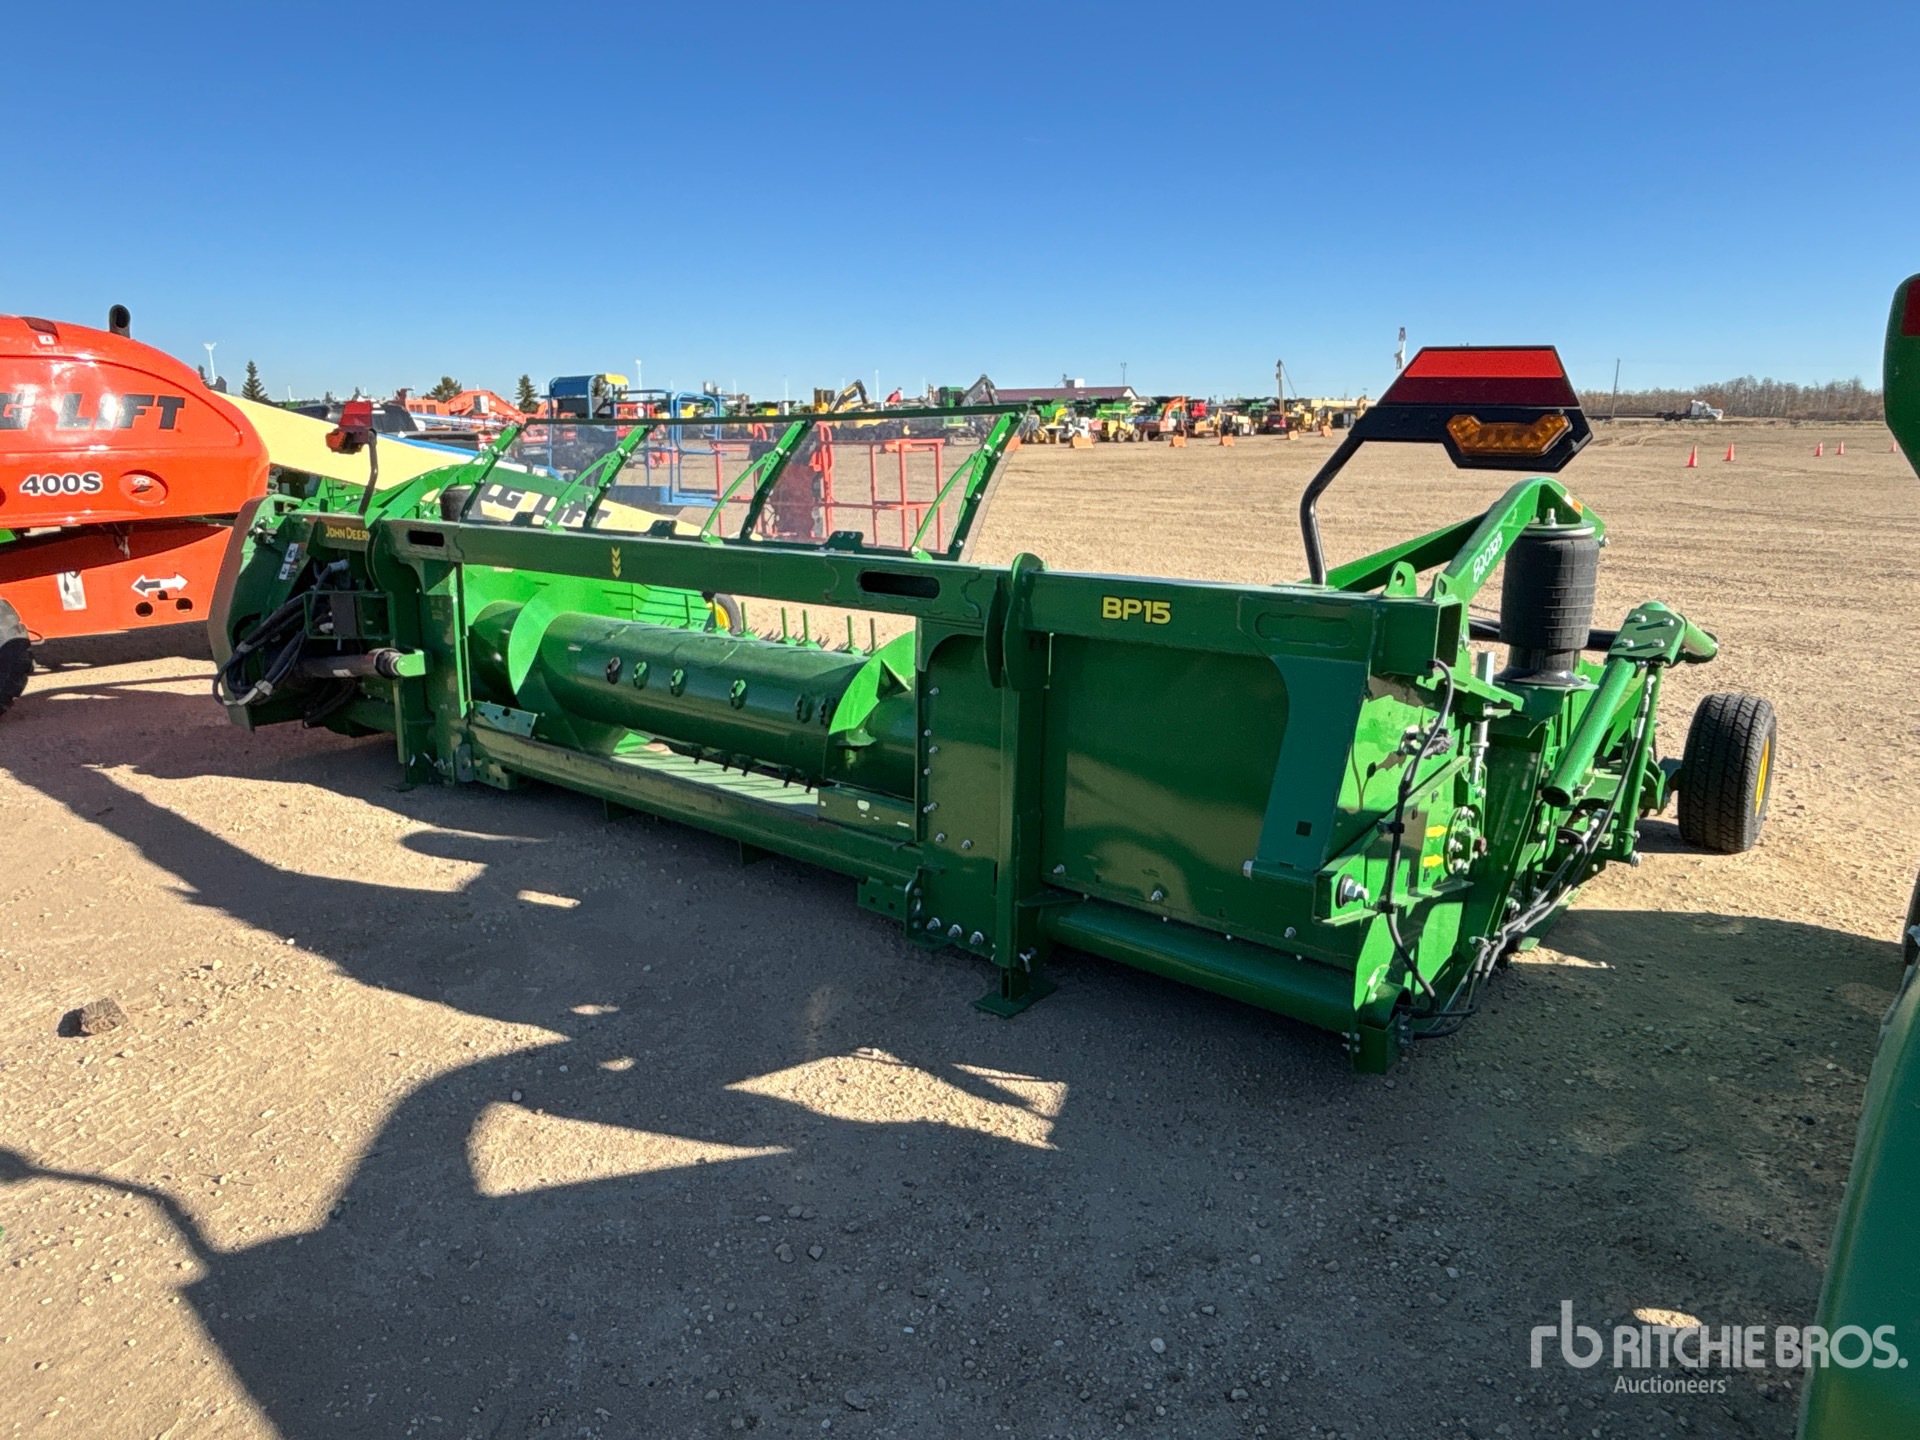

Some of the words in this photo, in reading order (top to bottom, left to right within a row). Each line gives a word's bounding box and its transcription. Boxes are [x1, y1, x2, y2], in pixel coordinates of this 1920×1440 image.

[57, 393, 186, 430] LIFT
[20, 472, 104, 497] 400S
[326, 525, 346, 539] JOHN
[345, 526, 371, 542] DEER
[1102, 596, 1171, 625] BP15
